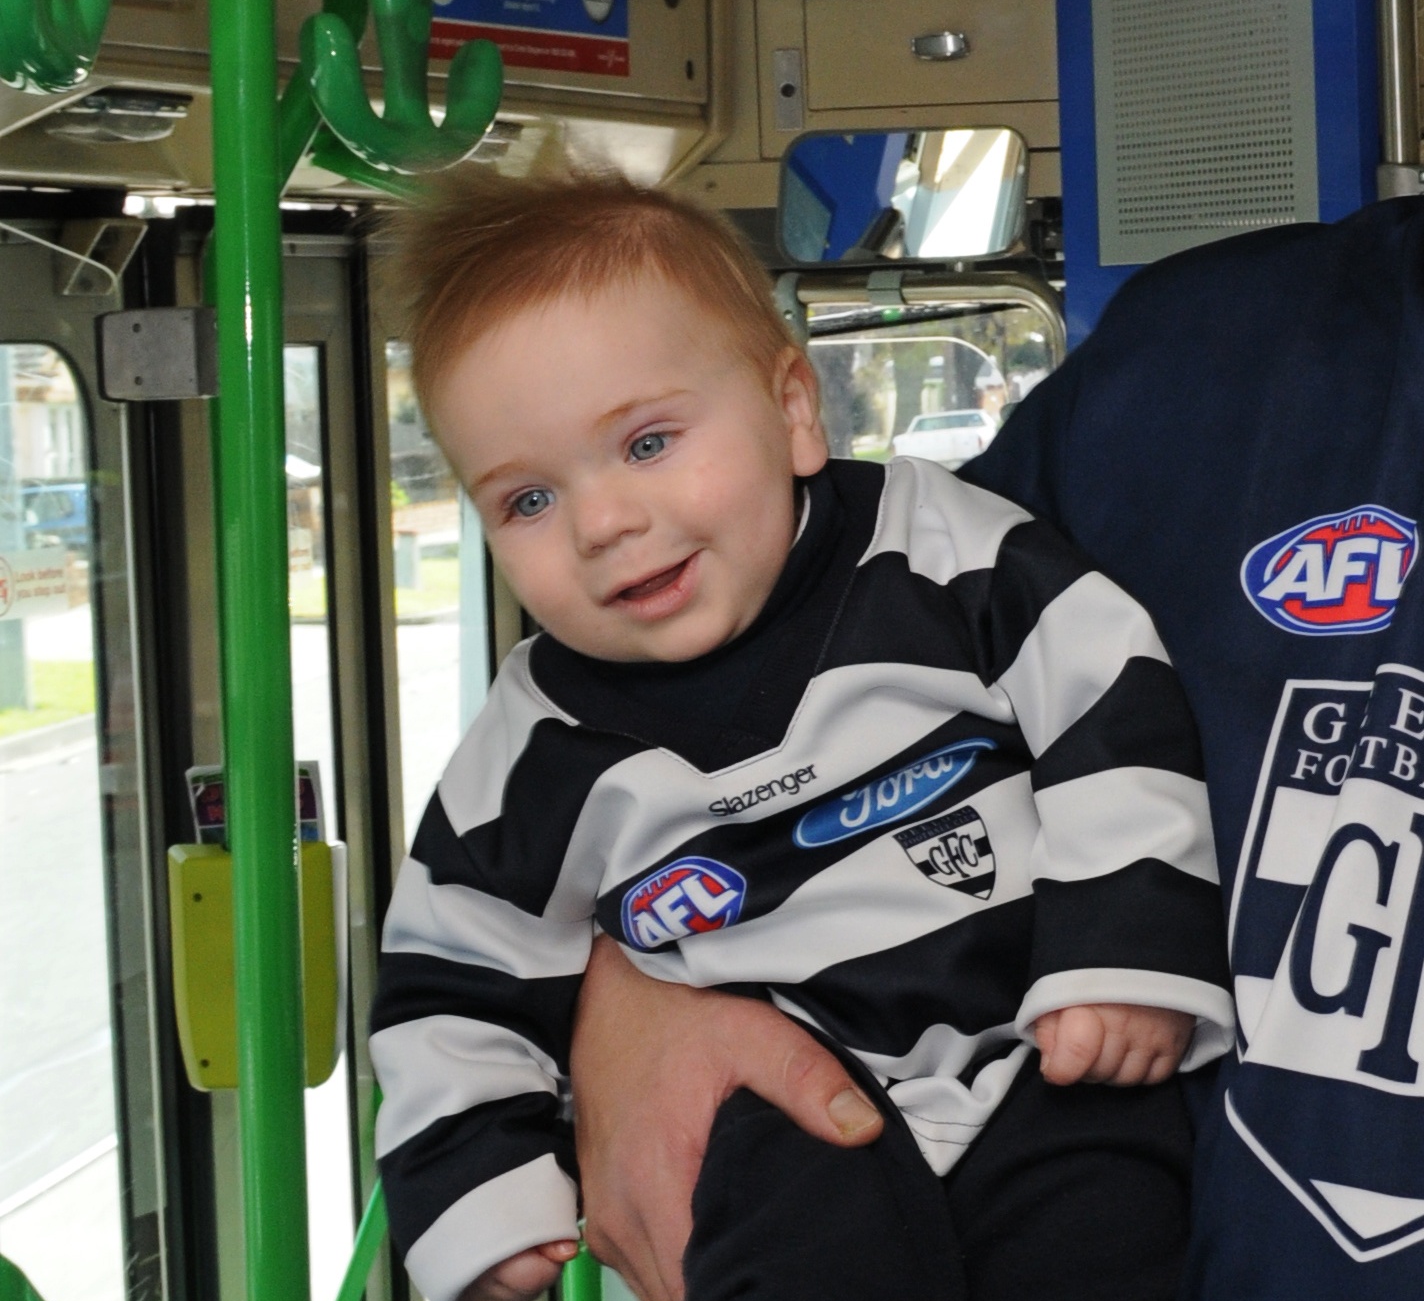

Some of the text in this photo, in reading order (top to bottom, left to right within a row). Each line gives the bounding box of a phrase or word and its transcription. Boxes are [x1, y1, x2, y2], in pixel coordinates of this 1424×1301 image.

[708, 764, 818, 817] Slazenger
[928, 831, 979, 879] GFC
[632, 872, 741, 949] AFL
